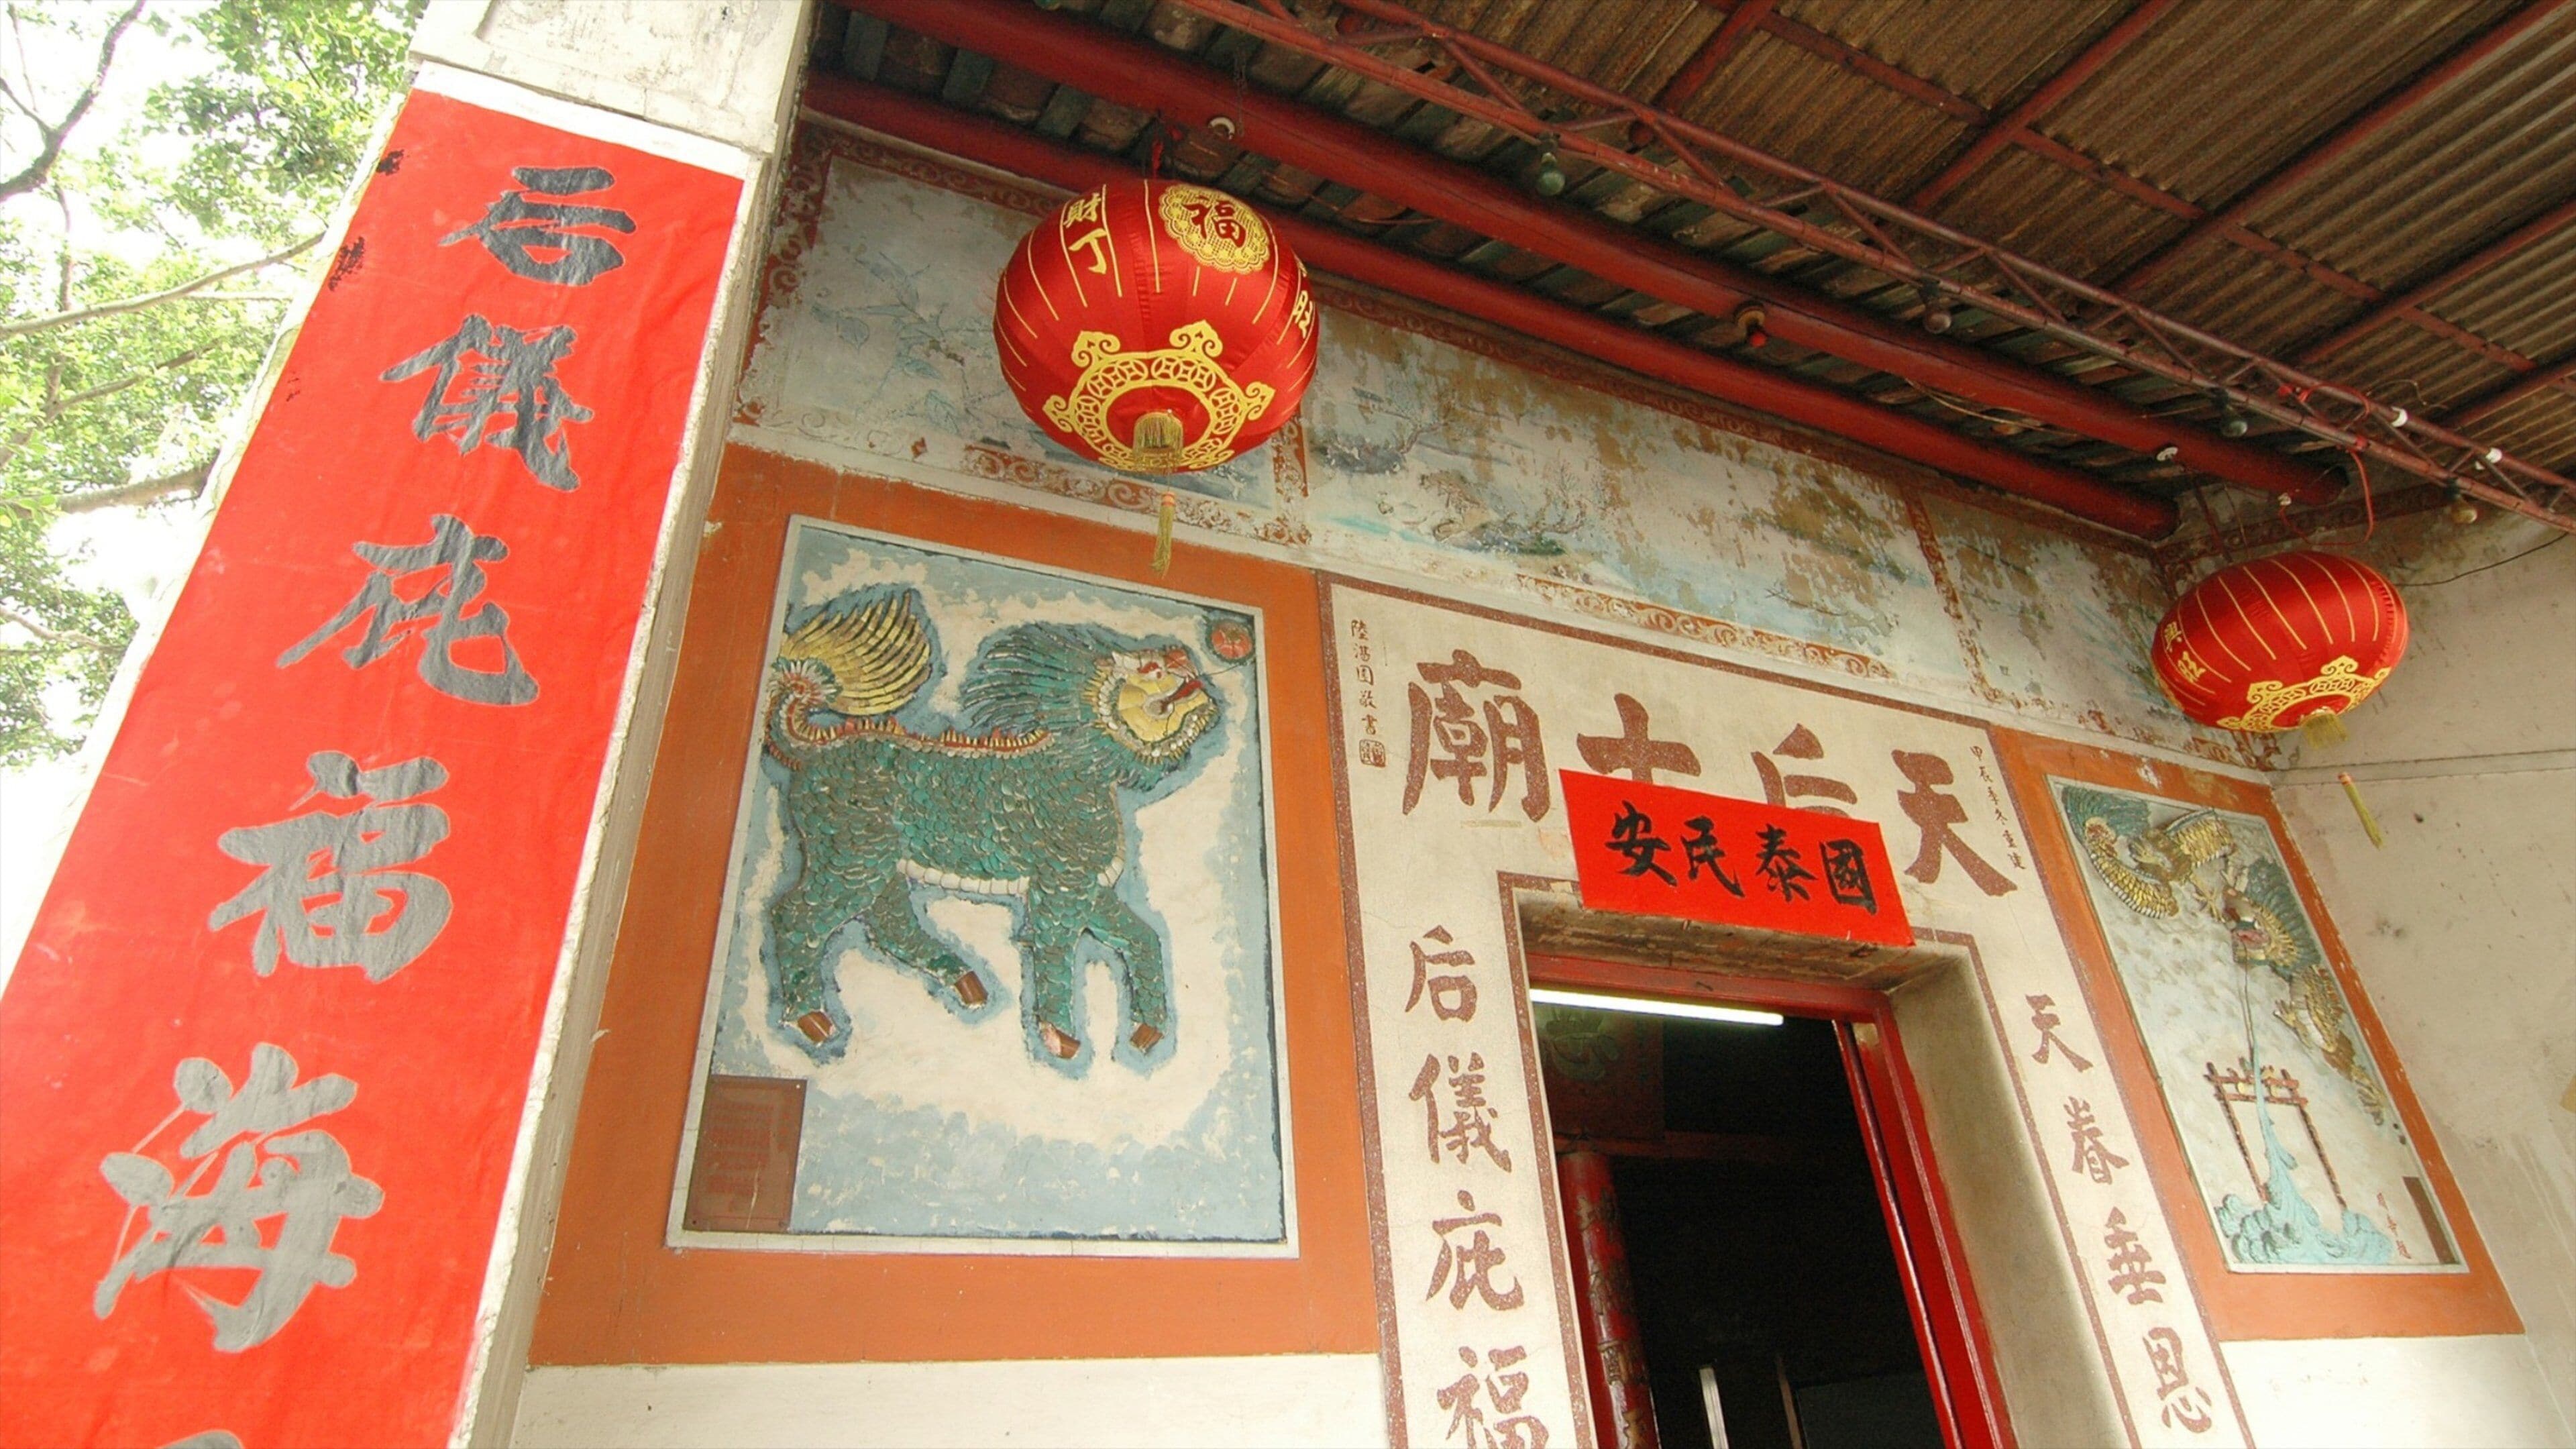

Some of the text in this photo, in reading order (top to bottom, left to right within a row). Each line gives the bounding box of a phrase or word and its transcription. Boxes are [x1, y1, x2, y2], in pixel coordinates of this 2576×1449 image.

[1183, 195, 1247, 248] 福
[94, 166, 637, 1449] 后儀庇福海
[1605, 799, 1877, 915] 國泰民安
[1405, 924, 1549, 1449] 后儀庇福
